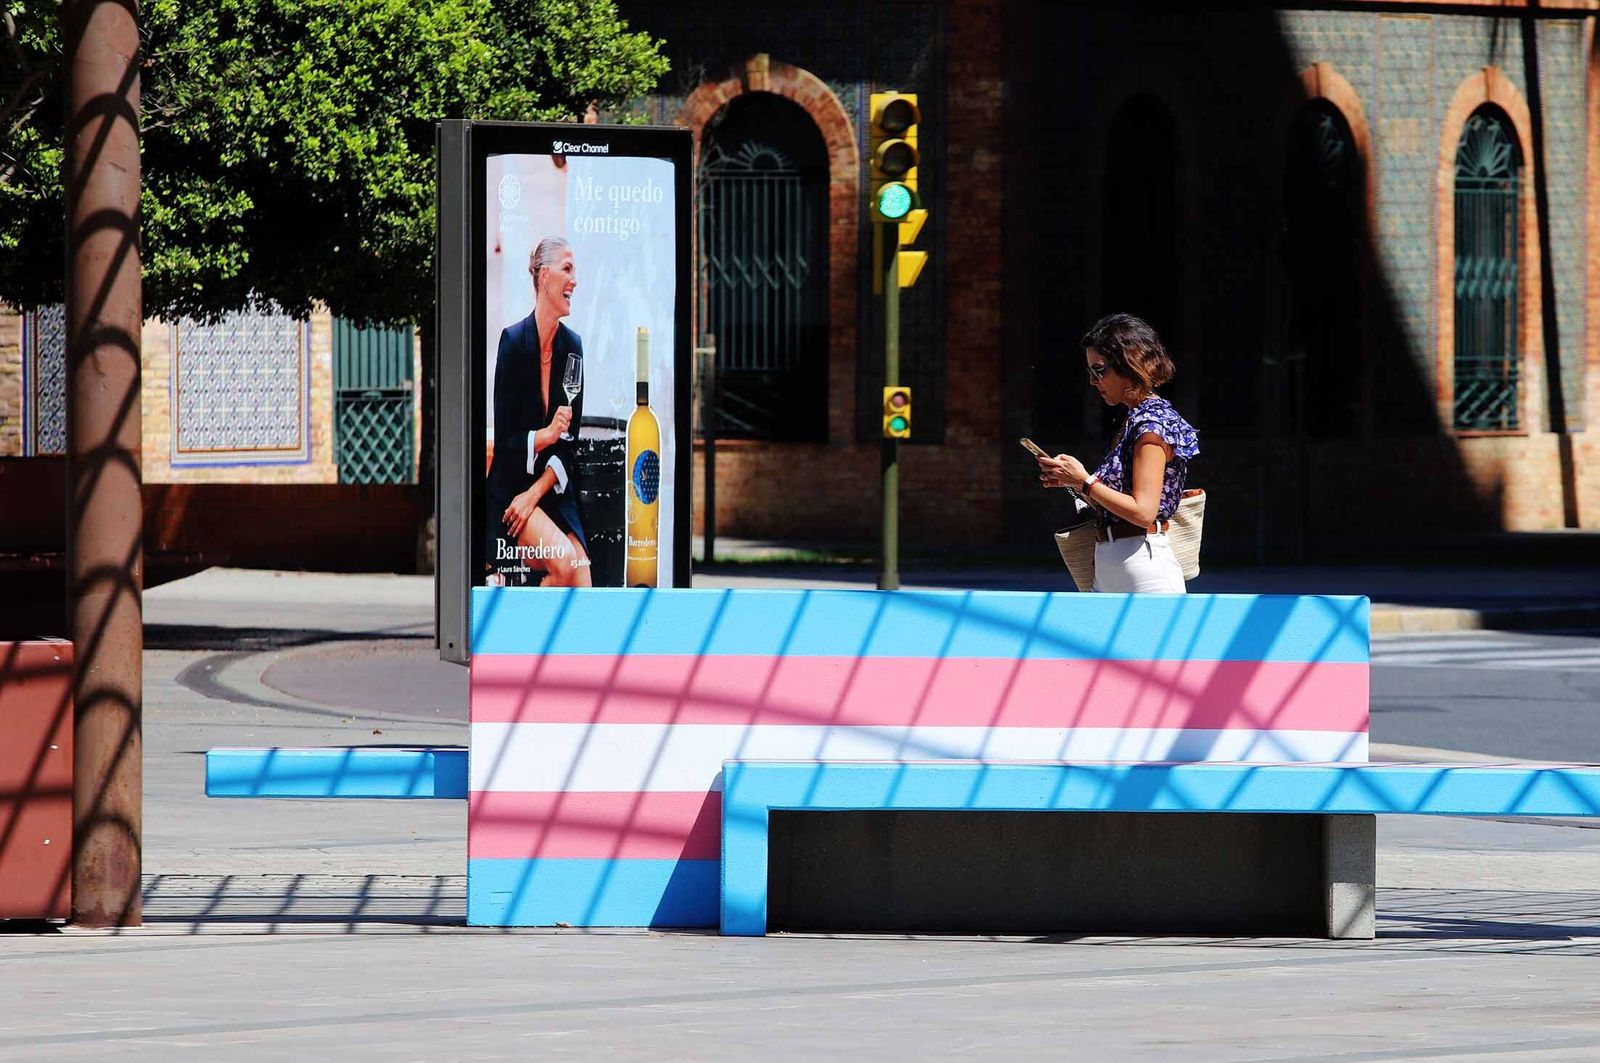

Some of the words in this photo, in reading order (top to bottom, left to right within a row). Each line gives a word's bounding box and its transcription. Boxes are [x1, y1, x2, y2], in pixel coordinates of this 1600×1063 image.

[563, 142, 581, 153] Clear
[581, 142, 609, 153] Channel
[574, 175, 603, 201] Me
[608, 177, 663, 208] quedo
[574, 209, 640, 241] contigo
[496, 537, 565, 560] Barredero
[500, 565, 513, 573] Laura
